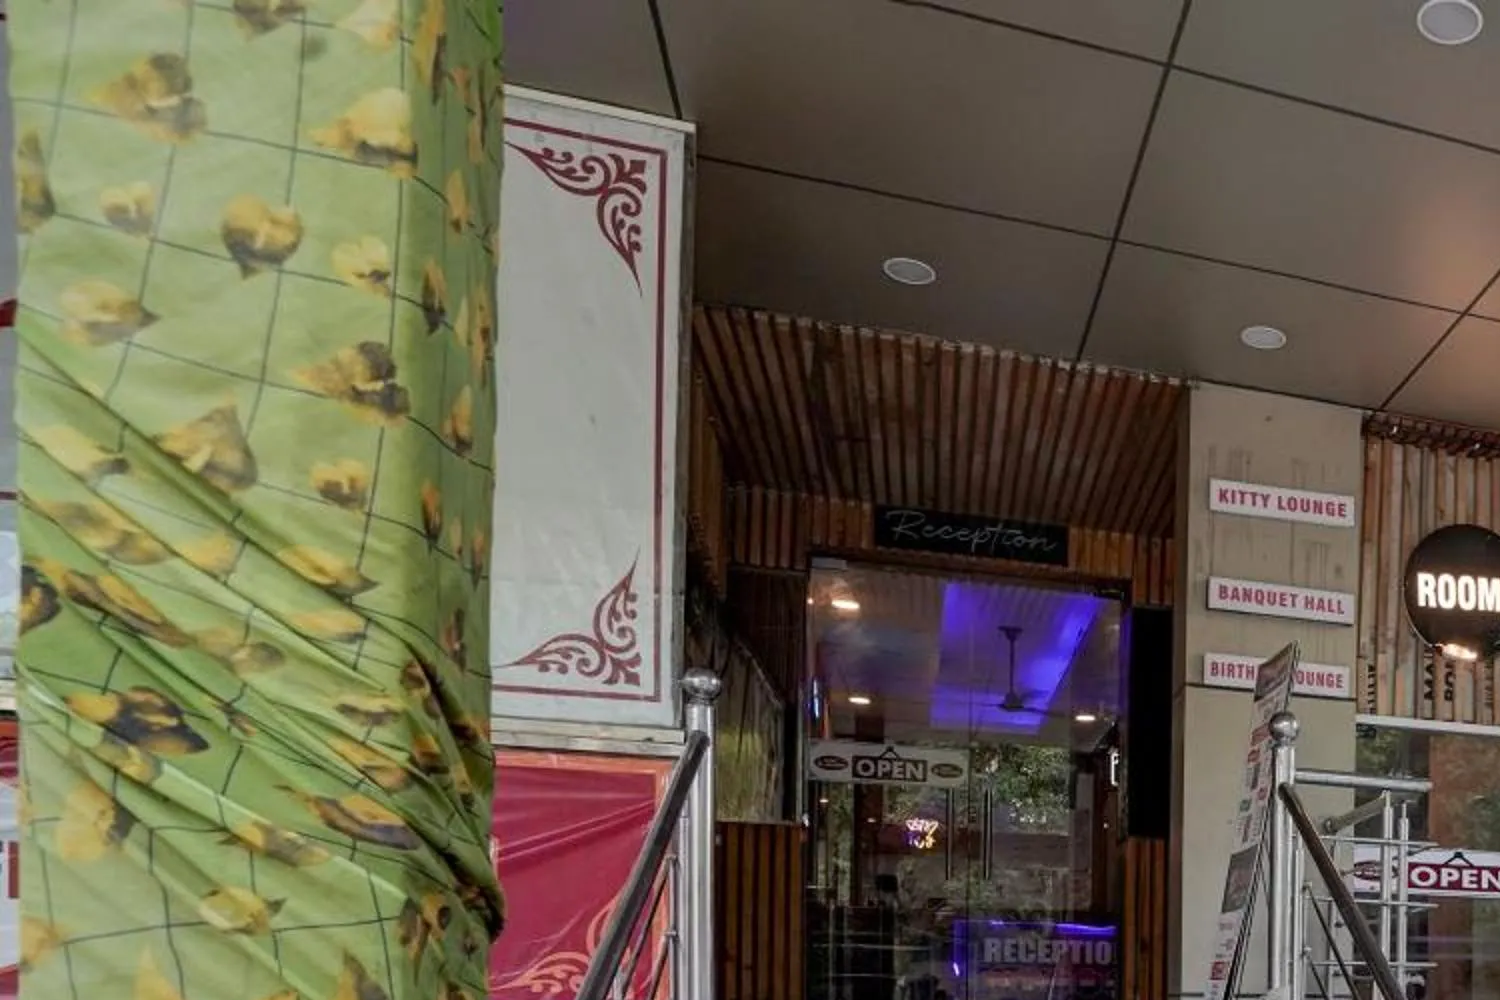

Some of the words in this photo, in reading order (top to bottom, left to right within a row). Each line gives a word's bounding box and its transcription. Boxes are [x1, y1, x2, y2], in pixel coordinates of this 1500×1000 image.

[1218, 487, 1271, 508] KITTY
[1277, 495, 1347, 518] LOUNGE
[885, 509, 1057, 554] Reception
[1218, 584, 1300, 608] BANQUET
[1304, 595, 1345, 615] HALL
[1209, 661, 1260, 684] BIRTH
[1294, 669, 1344, 689] OUNGE
[856, 758, 925, 781] OPEN
[984, 936, 1117, 965] RECEPTIO
